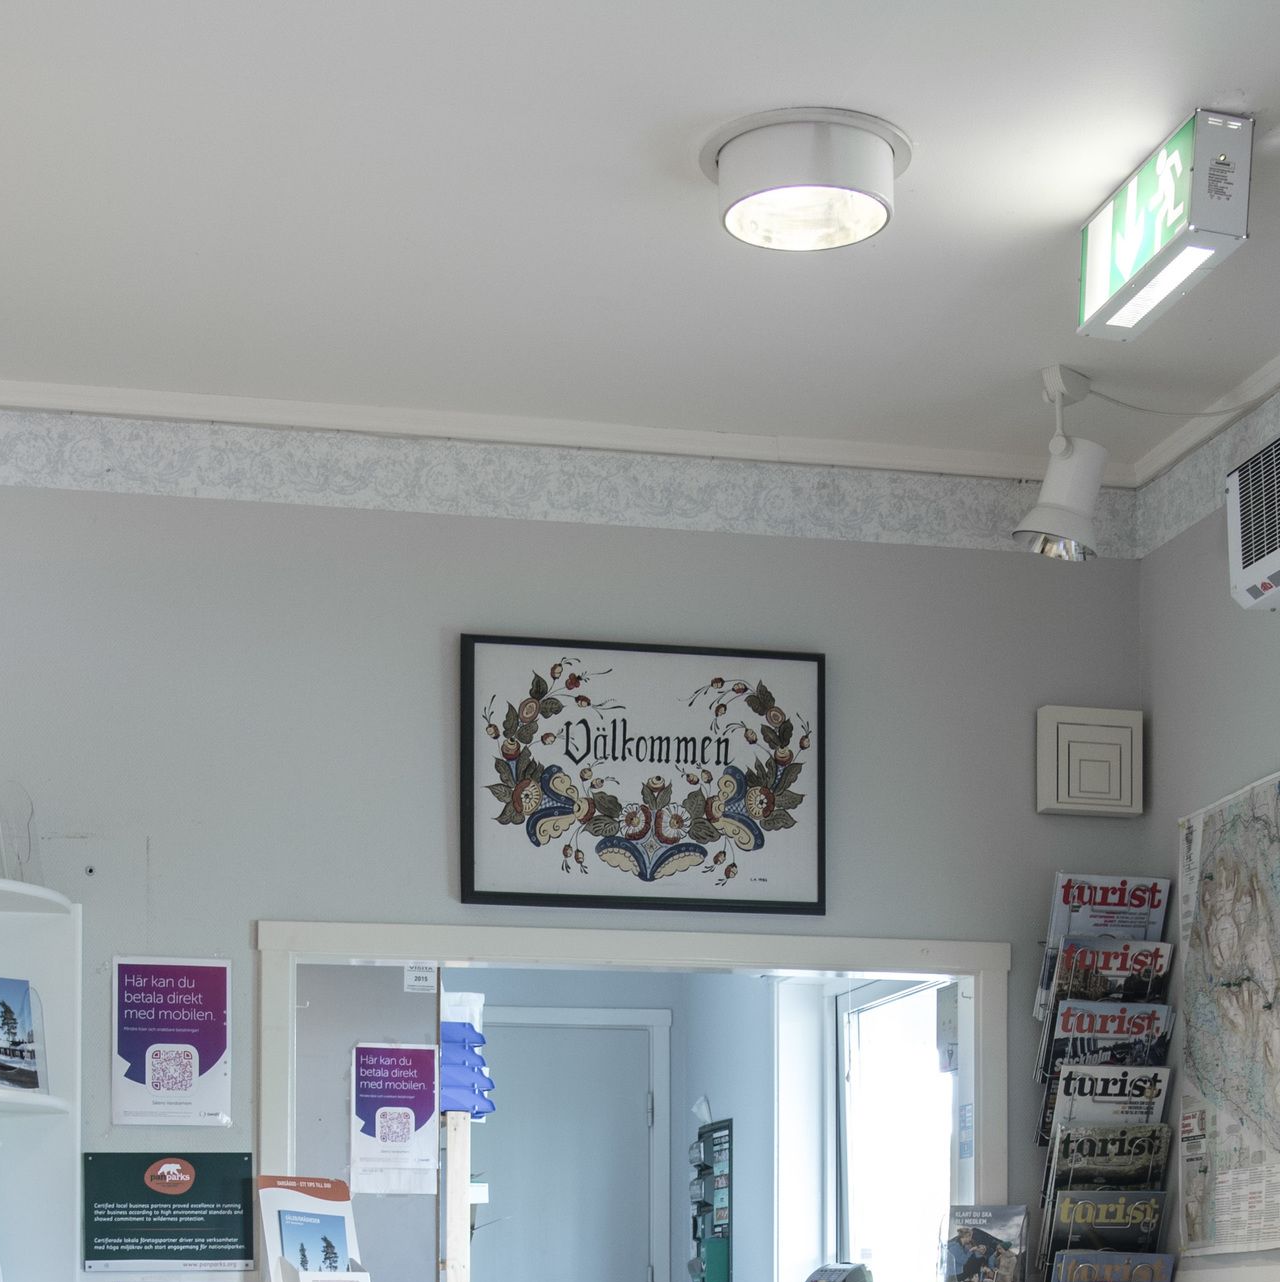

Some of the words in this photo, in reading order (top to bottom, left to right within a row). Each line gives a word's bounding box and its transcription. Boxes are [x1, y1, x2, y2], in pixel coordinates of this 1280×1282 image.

[564, 718, 735, 766] Välkommen
[1062, 878, 1162, 909] turist
[1063, 943, 1164, 973] turist
[125, 974, 148, 987] Här
[151, 975, 174, 988] kan
[178, 976, 195, 988] du
[124, 990, 163, 1004] betala
[167, 992, 203, 1005] direkt
[124, 1007, 155, 1020] med
[159, 1008, 216, 1021] mobilen.
[1061, 1006, 1160, 1035] turist
[360, 1055, 378, 1065] Här
[379, 1056, 396, 1066] kan
[399, 1056, 412, 1066] du
[360, 1068, 389, 1077] betala
[391, 1068, 418, 1078] direkt
[360, 1080, 382, 1089] med
[385, 1080, 427, 1090] mobilen.
[1063, 1071, 1162, 1098] turist
[1062, 1129, 1161, 1159] turist
[150, 1173, 190, 1182] panparks
[1059, 1197, 1160, 1224] turist
[1067, 1258, 1167, 1282] turist
